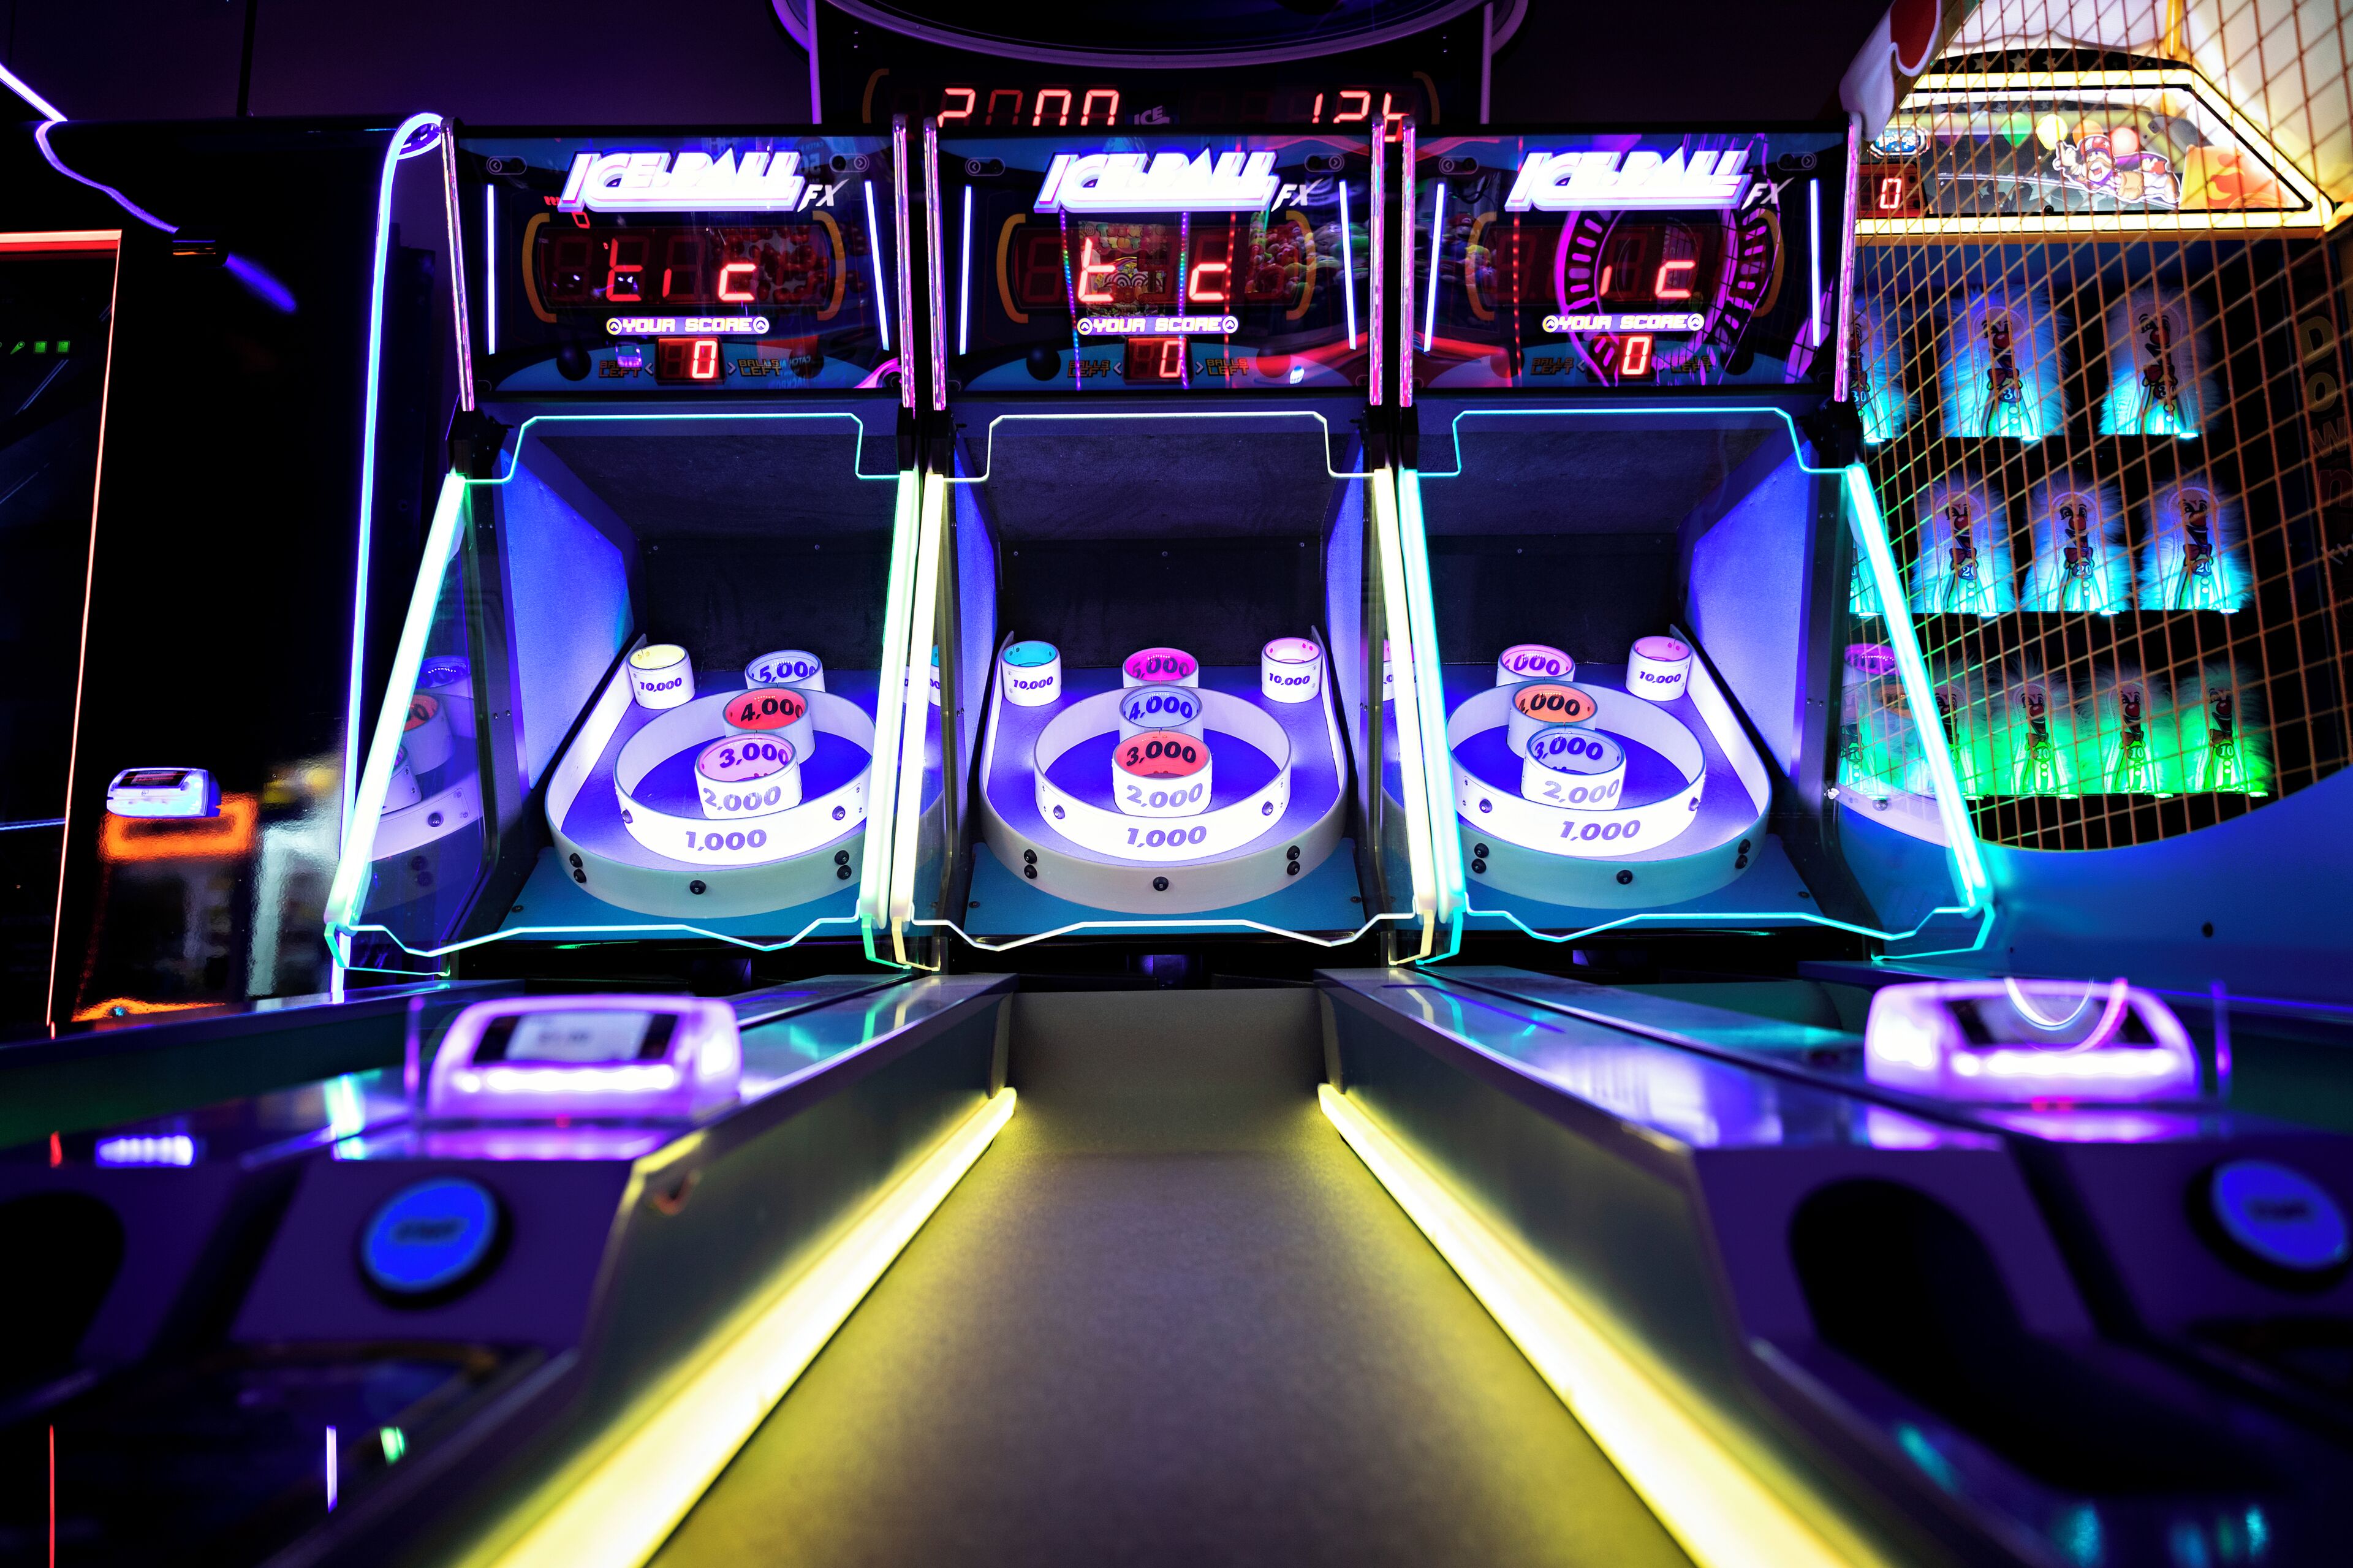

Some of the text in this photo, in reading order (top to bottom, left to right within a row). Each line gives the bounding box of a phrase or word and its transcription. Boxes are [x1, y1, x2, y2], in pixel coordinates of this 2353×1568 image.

[1134, 105, 1170, 126] ICE
[797, 178, 850, 213] FX
[1270, 178, 1324, 213] FX
[1741, 177, 1795, 211] FX
[1879, 178, 1902, 209] 0
[622, 317, 753, 333] YOUR SCORE
[1093, 317, 1222, 333] YOUR SCORE
[1558, 314, 1689, 330] YOUR SCORE
[691, 340, 718, 379] 0
[1159, 340, 1185, 378] 0
[1206, 358, 1248, 367] BALLS
[1532, 357, 1574, 366] BALLS
[1622, 336, 1650, 374] 0
[599, 367, 642, 377] LEFT
[740, 366, 782, 377] LEFT
[1067, 367, 1111, 378] LEFT
[1208, 366, 1249, 376] LEFT
[1531, 365, 1574, 376] LEFT
[2196, 562, 2211, 573] 20
[1132, 657, 1190, 680] 5,000
[1639, 670, 1682, 684] 10,000
[640, 677, 683, 692] 10,000
[1013, 675, 1055, 691] 10,000
[1268, 672, 1312, 687] 10,000
[1129, 695, 1193, 721] 4,000
[719, 742, 789, 768] 3,000
[1126, 741, 1197, 767] 3,000
[1534, 735, 1604, 760] 3,000
[2036, 748, 2050, 760] 10
[2131, 746, 2144, 759] 10
[2219, 744, 2235, 757] 10
[702, 785, 782, 812] 2,000
[1126, 782, 1203, 809] 2,000
[1542, 778, 1620, 805] 2,000
[685, 828, 768, 852] 1,000
[1126, 825, 1208, 849] 1,000
[1559, 819, 1642, 842] 1,000
